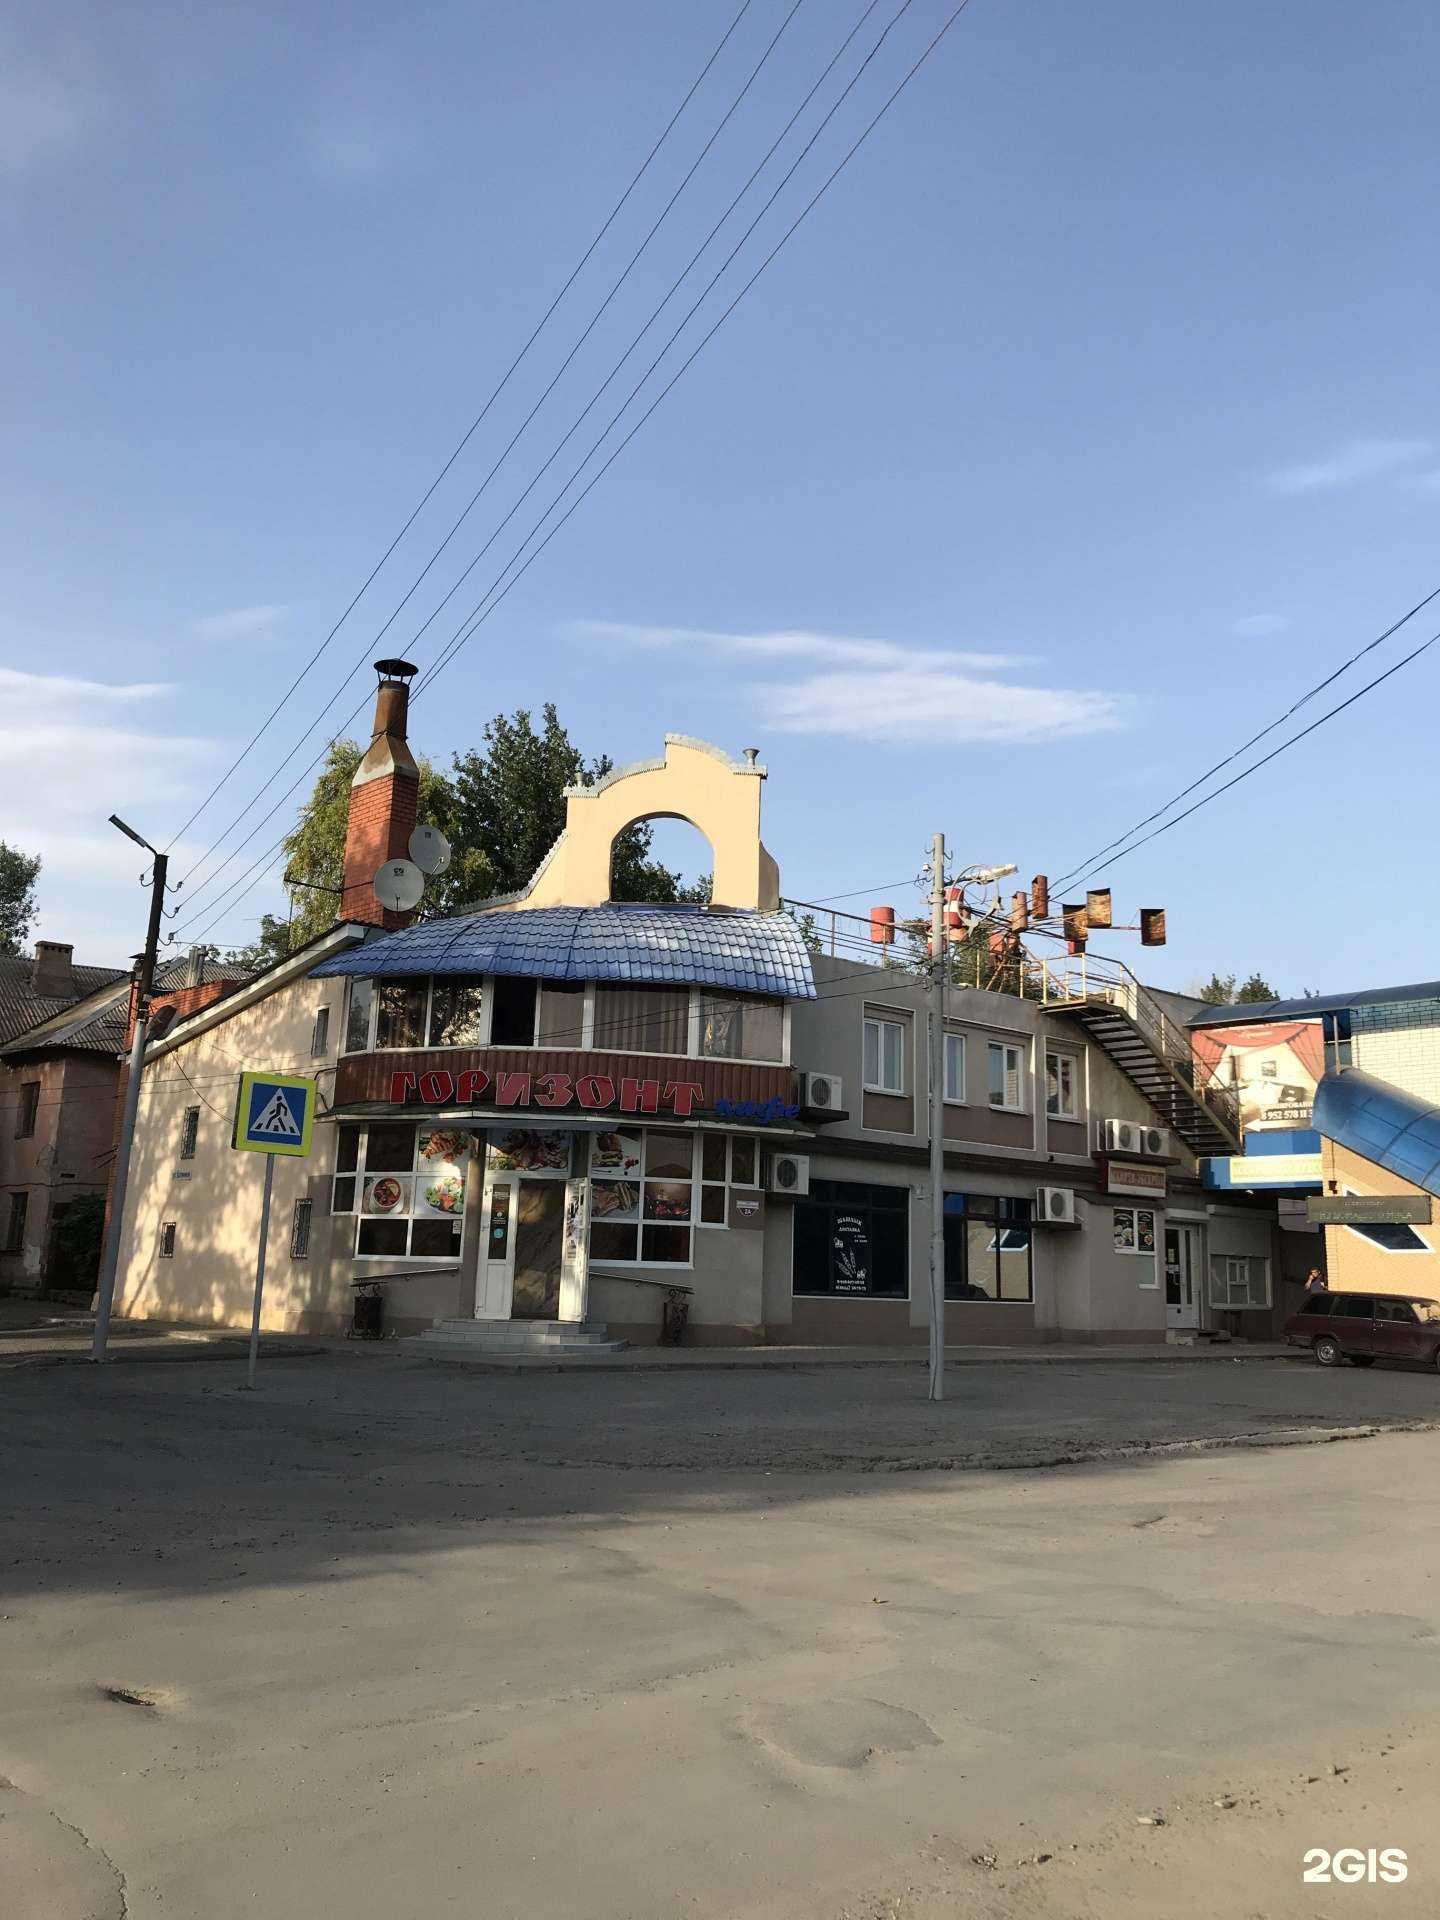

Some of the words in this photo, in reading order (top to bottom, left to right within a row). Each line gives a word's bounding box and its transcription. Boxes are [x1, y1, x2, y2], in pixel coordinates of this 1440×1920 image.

[389, 1069, 704, 1116] ГОРИЗОНТ
[1268, 1111, 1283, 1120] 952
[1284, 1109, 1299, 1119] 578
